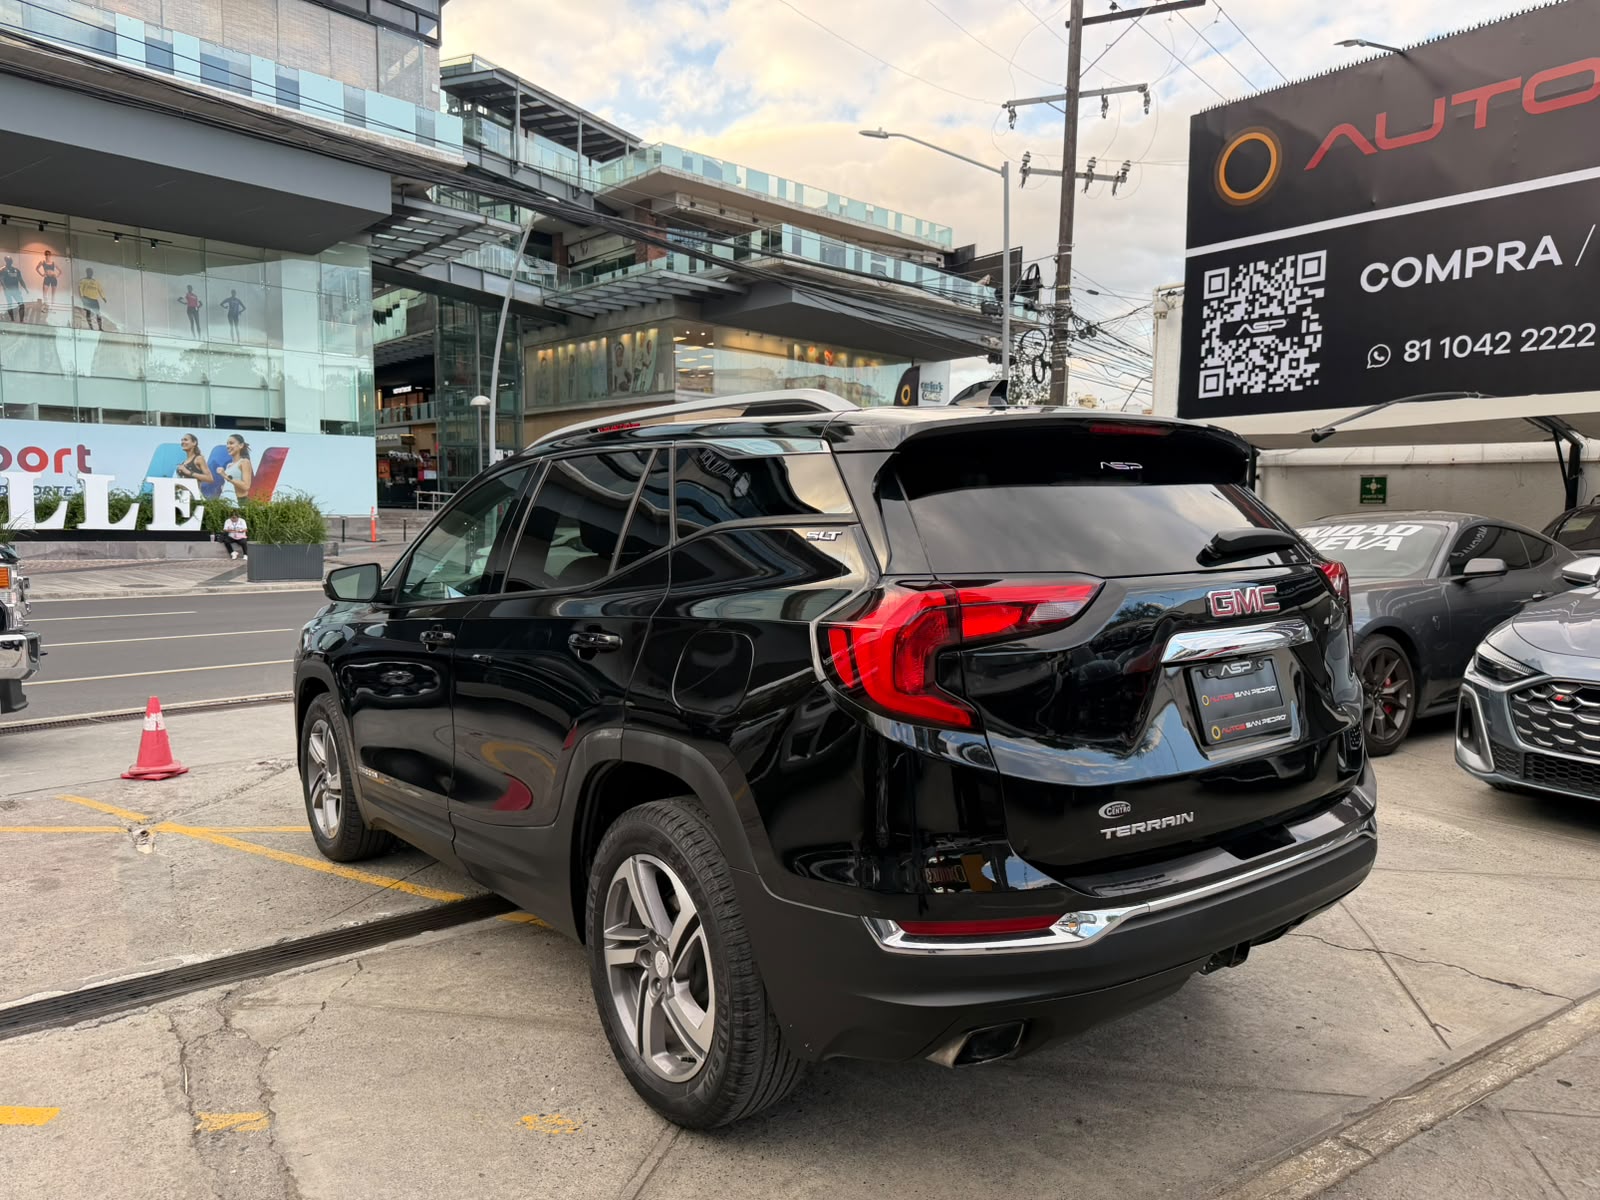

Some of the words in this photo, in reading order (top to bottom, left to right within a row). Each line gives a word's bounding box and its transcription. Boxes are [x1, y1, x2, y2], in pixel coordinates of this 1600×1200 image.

[1360, 235, 1563, 293] COMPRA
[1236, 319, 1287, 335] ASP
[1403, 339, 1431, 362] 81
[1439, 331, 1512, 358] 1042
[1520, 322, 1596, 352] 2222
[806, 531, 843, 541] SLT
[1295, 524, 1424, 540] NIDAD
[1207, 584, 1280, 618] GMC
[1220, 660, 1252, 676] ASP
[1100, 811, 1194, 840] TERRAIN
